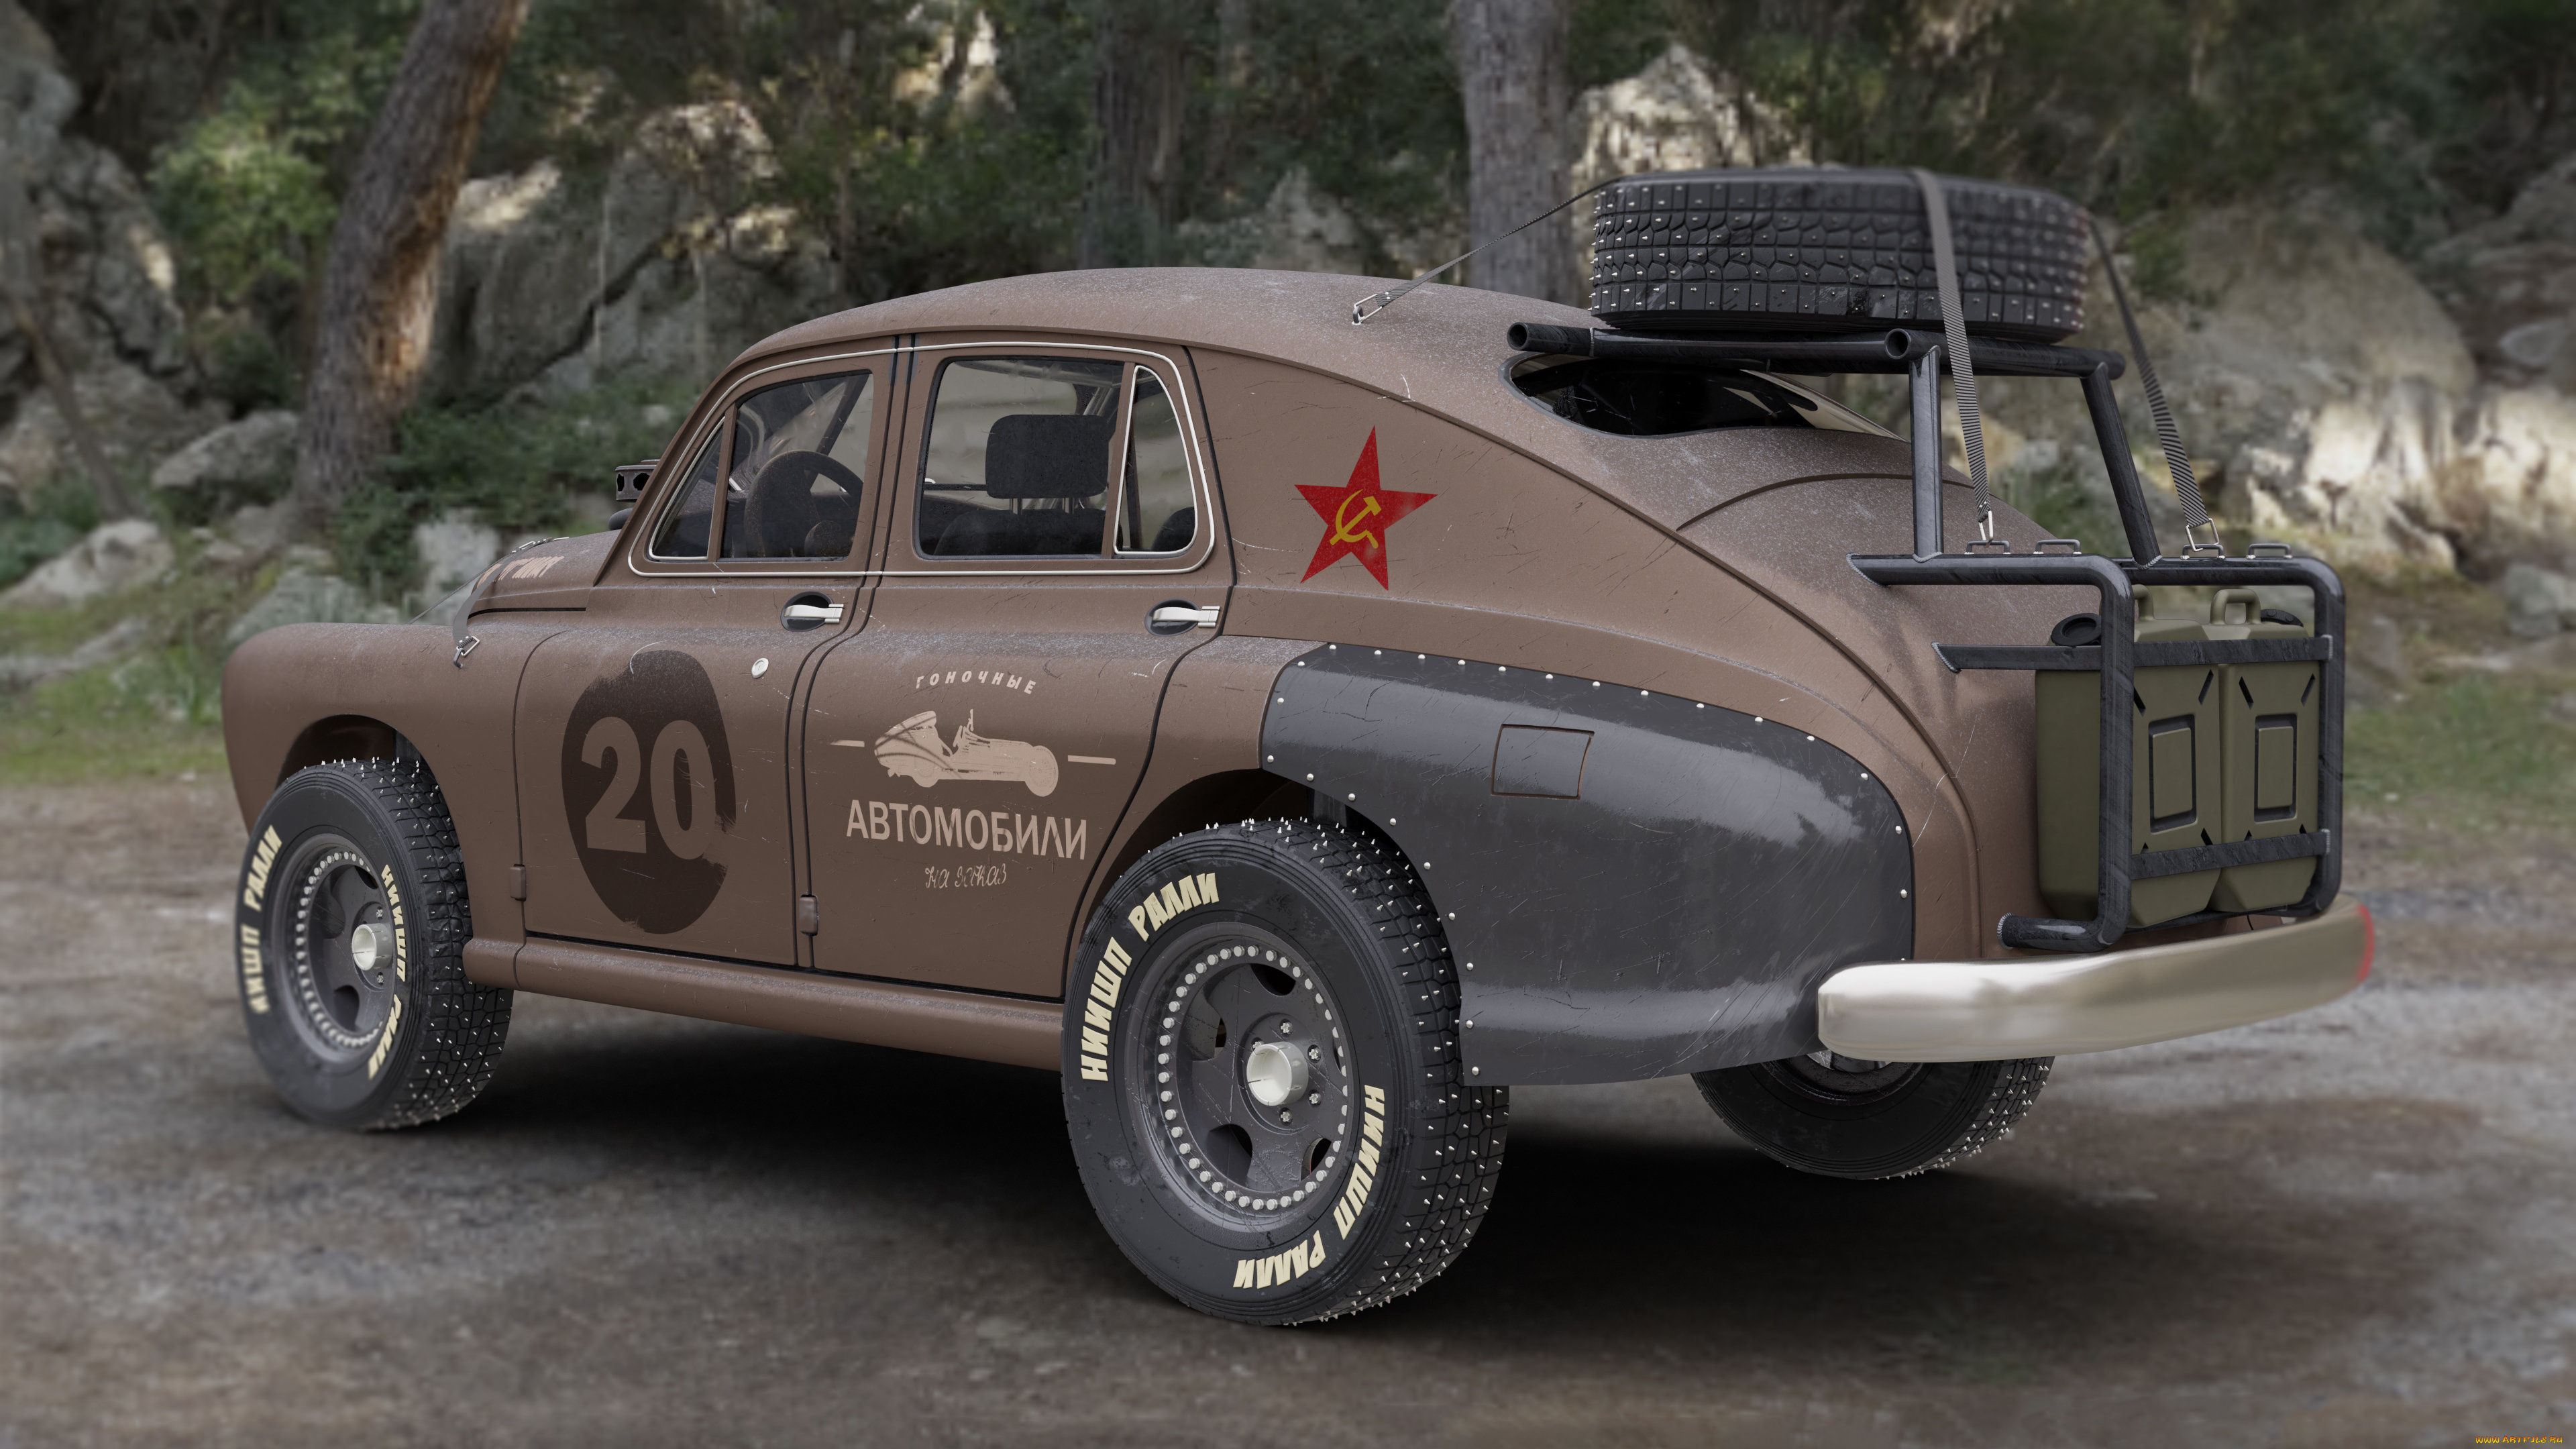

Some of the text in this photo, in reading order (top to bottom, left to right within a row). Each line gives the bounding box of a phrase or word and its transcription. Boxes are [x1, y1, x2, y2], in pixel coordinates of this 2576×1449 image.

[916, 671, 1036, 695] ГОНОЧНЫЕ
[581, 716, 716, 860] 20
[846, 799, 1087, 860] АВТОМОБИЛИ
[380, 864, 407, 982] НИИШП
[1080, 872, 1220, 1082] НИИШП РАЛЛИ
[1232, 1084, 1385, 1290] НИИШП РАЛЛИ
